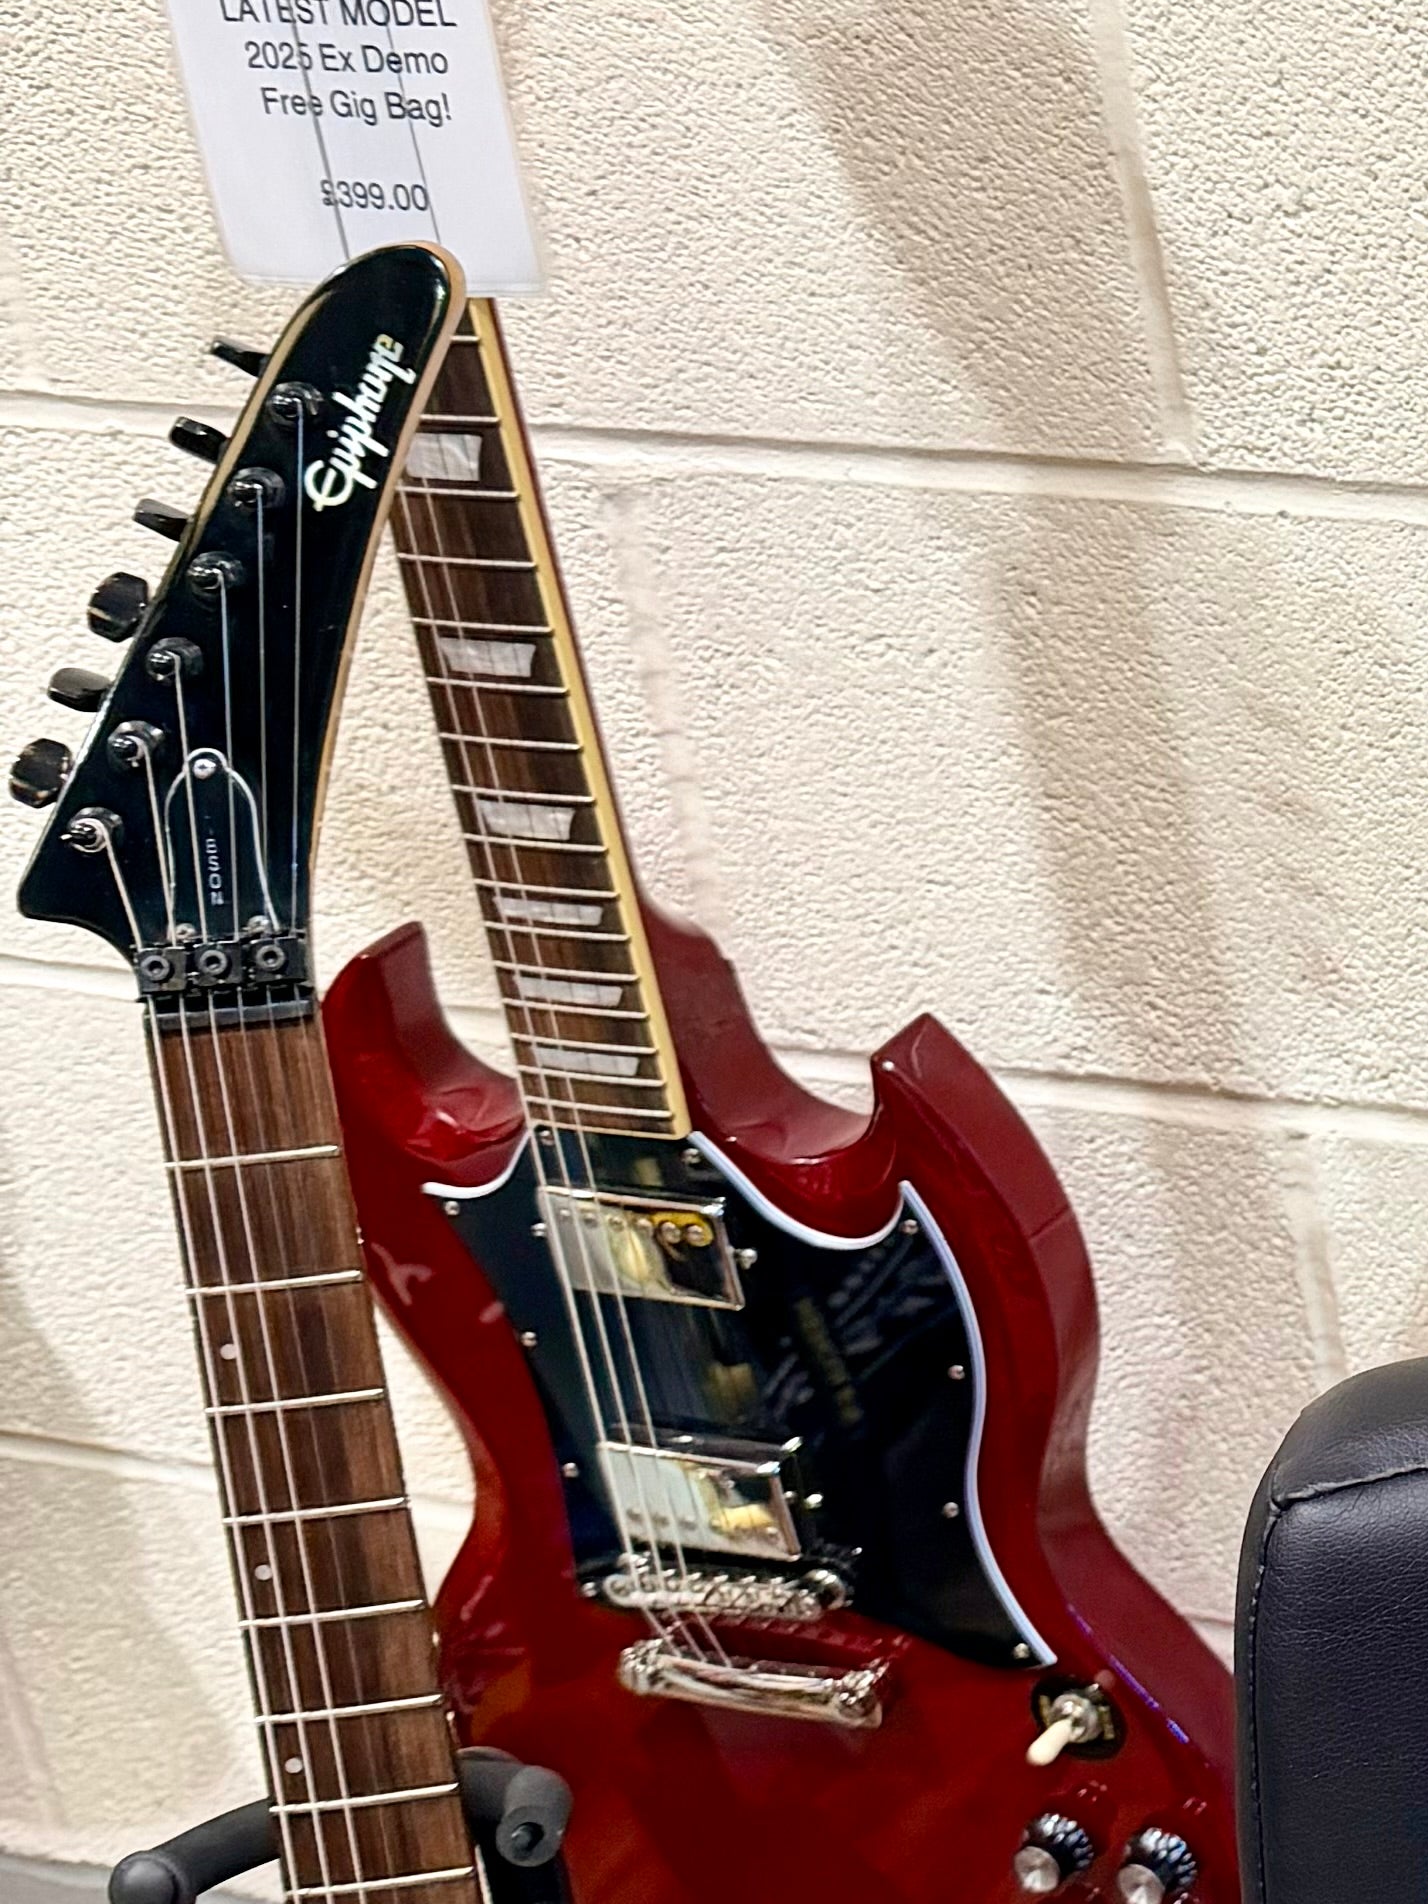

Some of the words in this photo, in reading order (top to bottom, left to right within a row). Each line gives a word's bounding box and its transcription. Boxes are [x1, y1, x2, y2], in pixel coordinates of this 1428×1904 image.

[245, 41, 313, 70] 2025
[318, 43, 357, 72] Ex
[360, 44, 449, 74] Demo
[260, 87, 324, 117] Free
[329, 89, 378, 127] Gig
[384, 91, 452, 128] Bag!
[320, 179, 430, 211] £399.00
[304, 333, 417, 512] Epiphone
